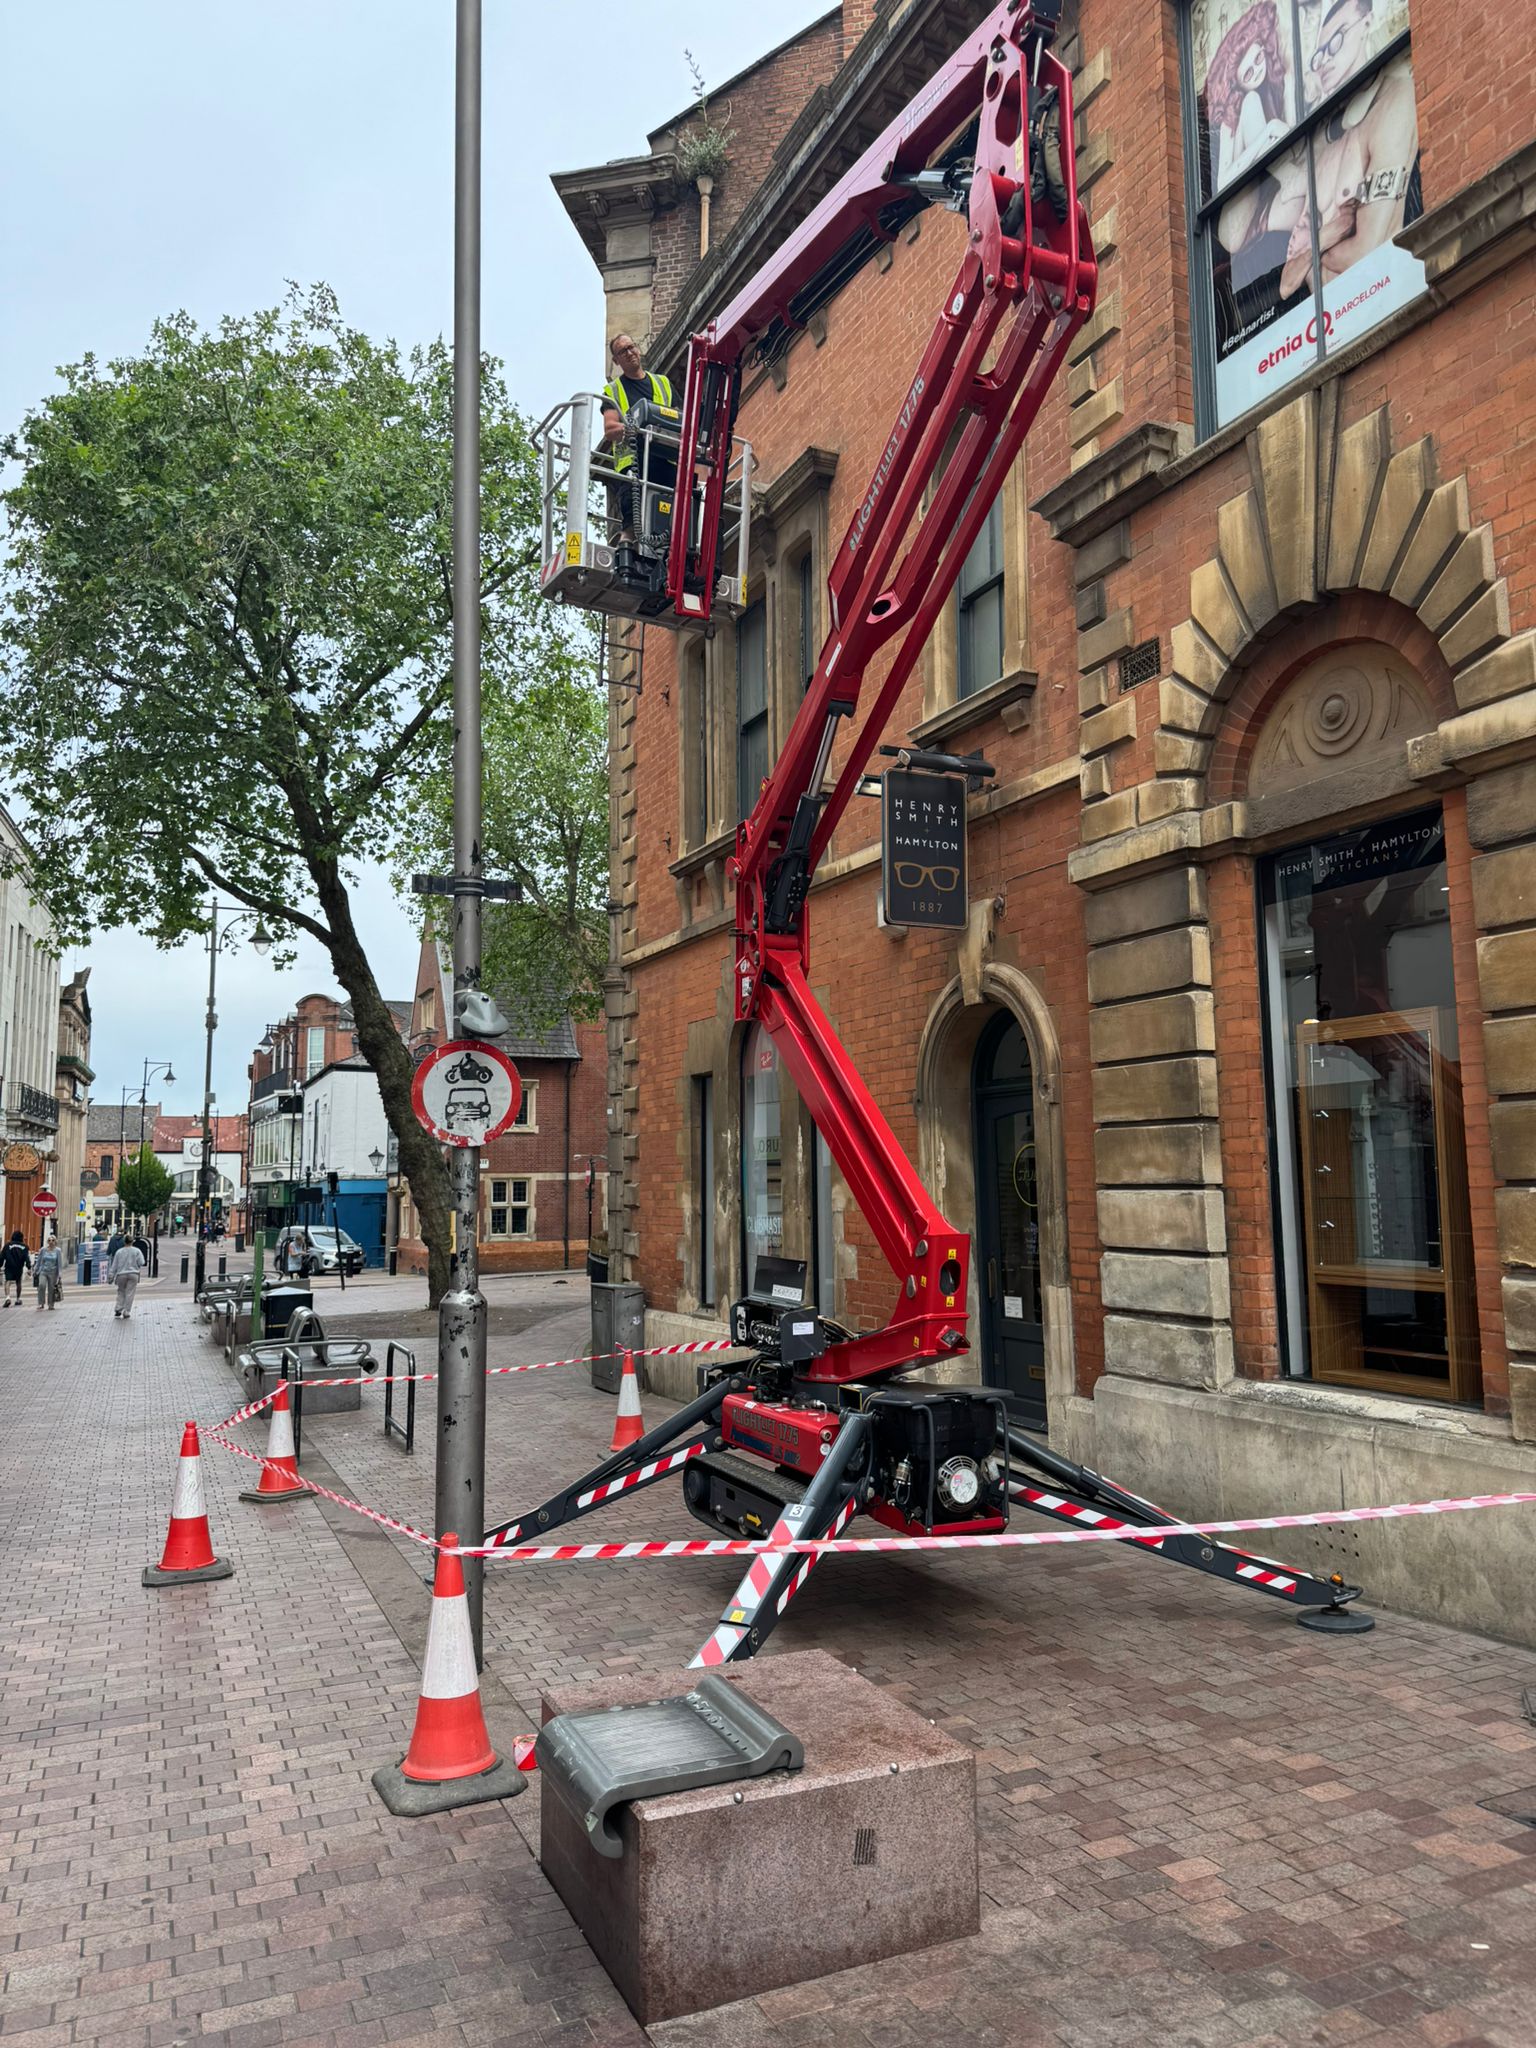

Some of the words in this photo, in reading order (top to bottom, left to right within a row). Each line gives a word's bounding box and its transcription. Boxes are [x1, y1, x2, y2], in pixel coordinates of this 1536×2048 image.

[1257, 333, 1303, 374] etnia
[1334, 276, 1391, 320] BARCELONA
[899, 377, 926, 431] 17.75
[895, 799, 957, 815] HENRY
[895, 811, 958, 827] SMITH
[895, 836, 958, 851] HAMYLTON
[1278, 859, 1314, 878] HENRY
[1318, 848, 1354, 866] SMITH
[1371, 825, 1442, 852] HAMYLTON
[1319, 851, 1400, 878] OPTICIANS
[912, 901, 943, 914] 1887
[792, 1506, 802, 1516] 3
